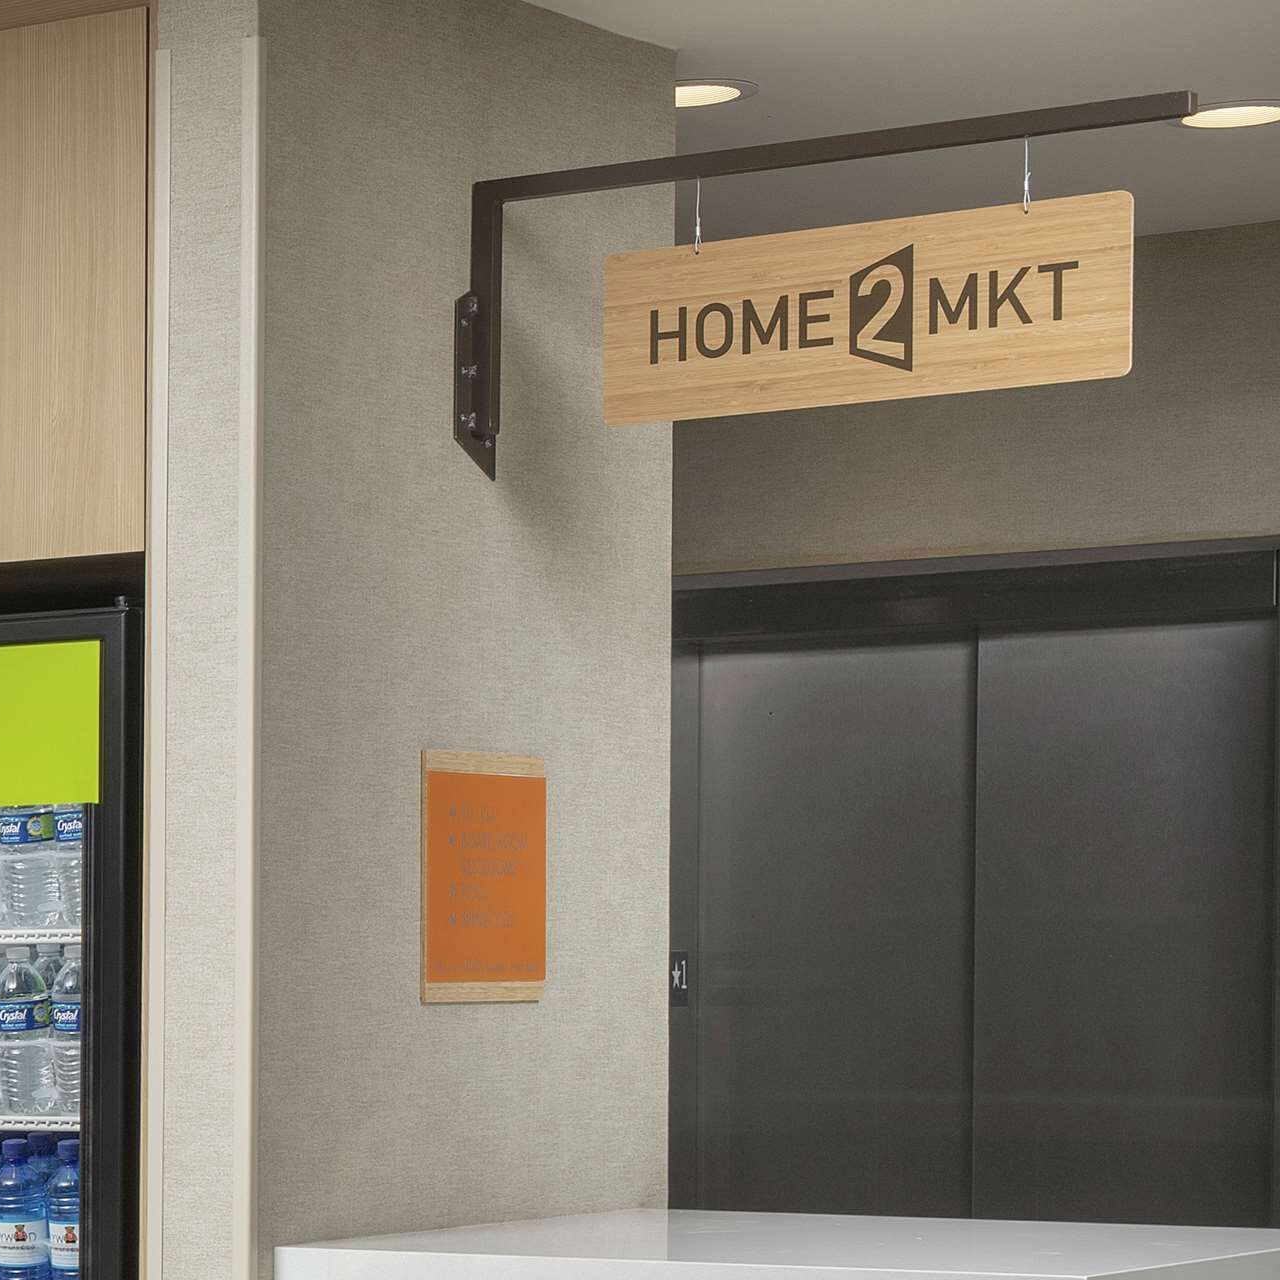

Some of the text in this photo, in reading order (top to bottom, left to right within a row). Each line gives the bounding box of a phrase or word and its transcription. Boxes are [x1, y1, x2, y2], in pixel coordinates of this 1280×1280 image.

[649, 254, 1080, 366] HOME 2 MKT
[0, 1009, 27, 1024] Crystal
